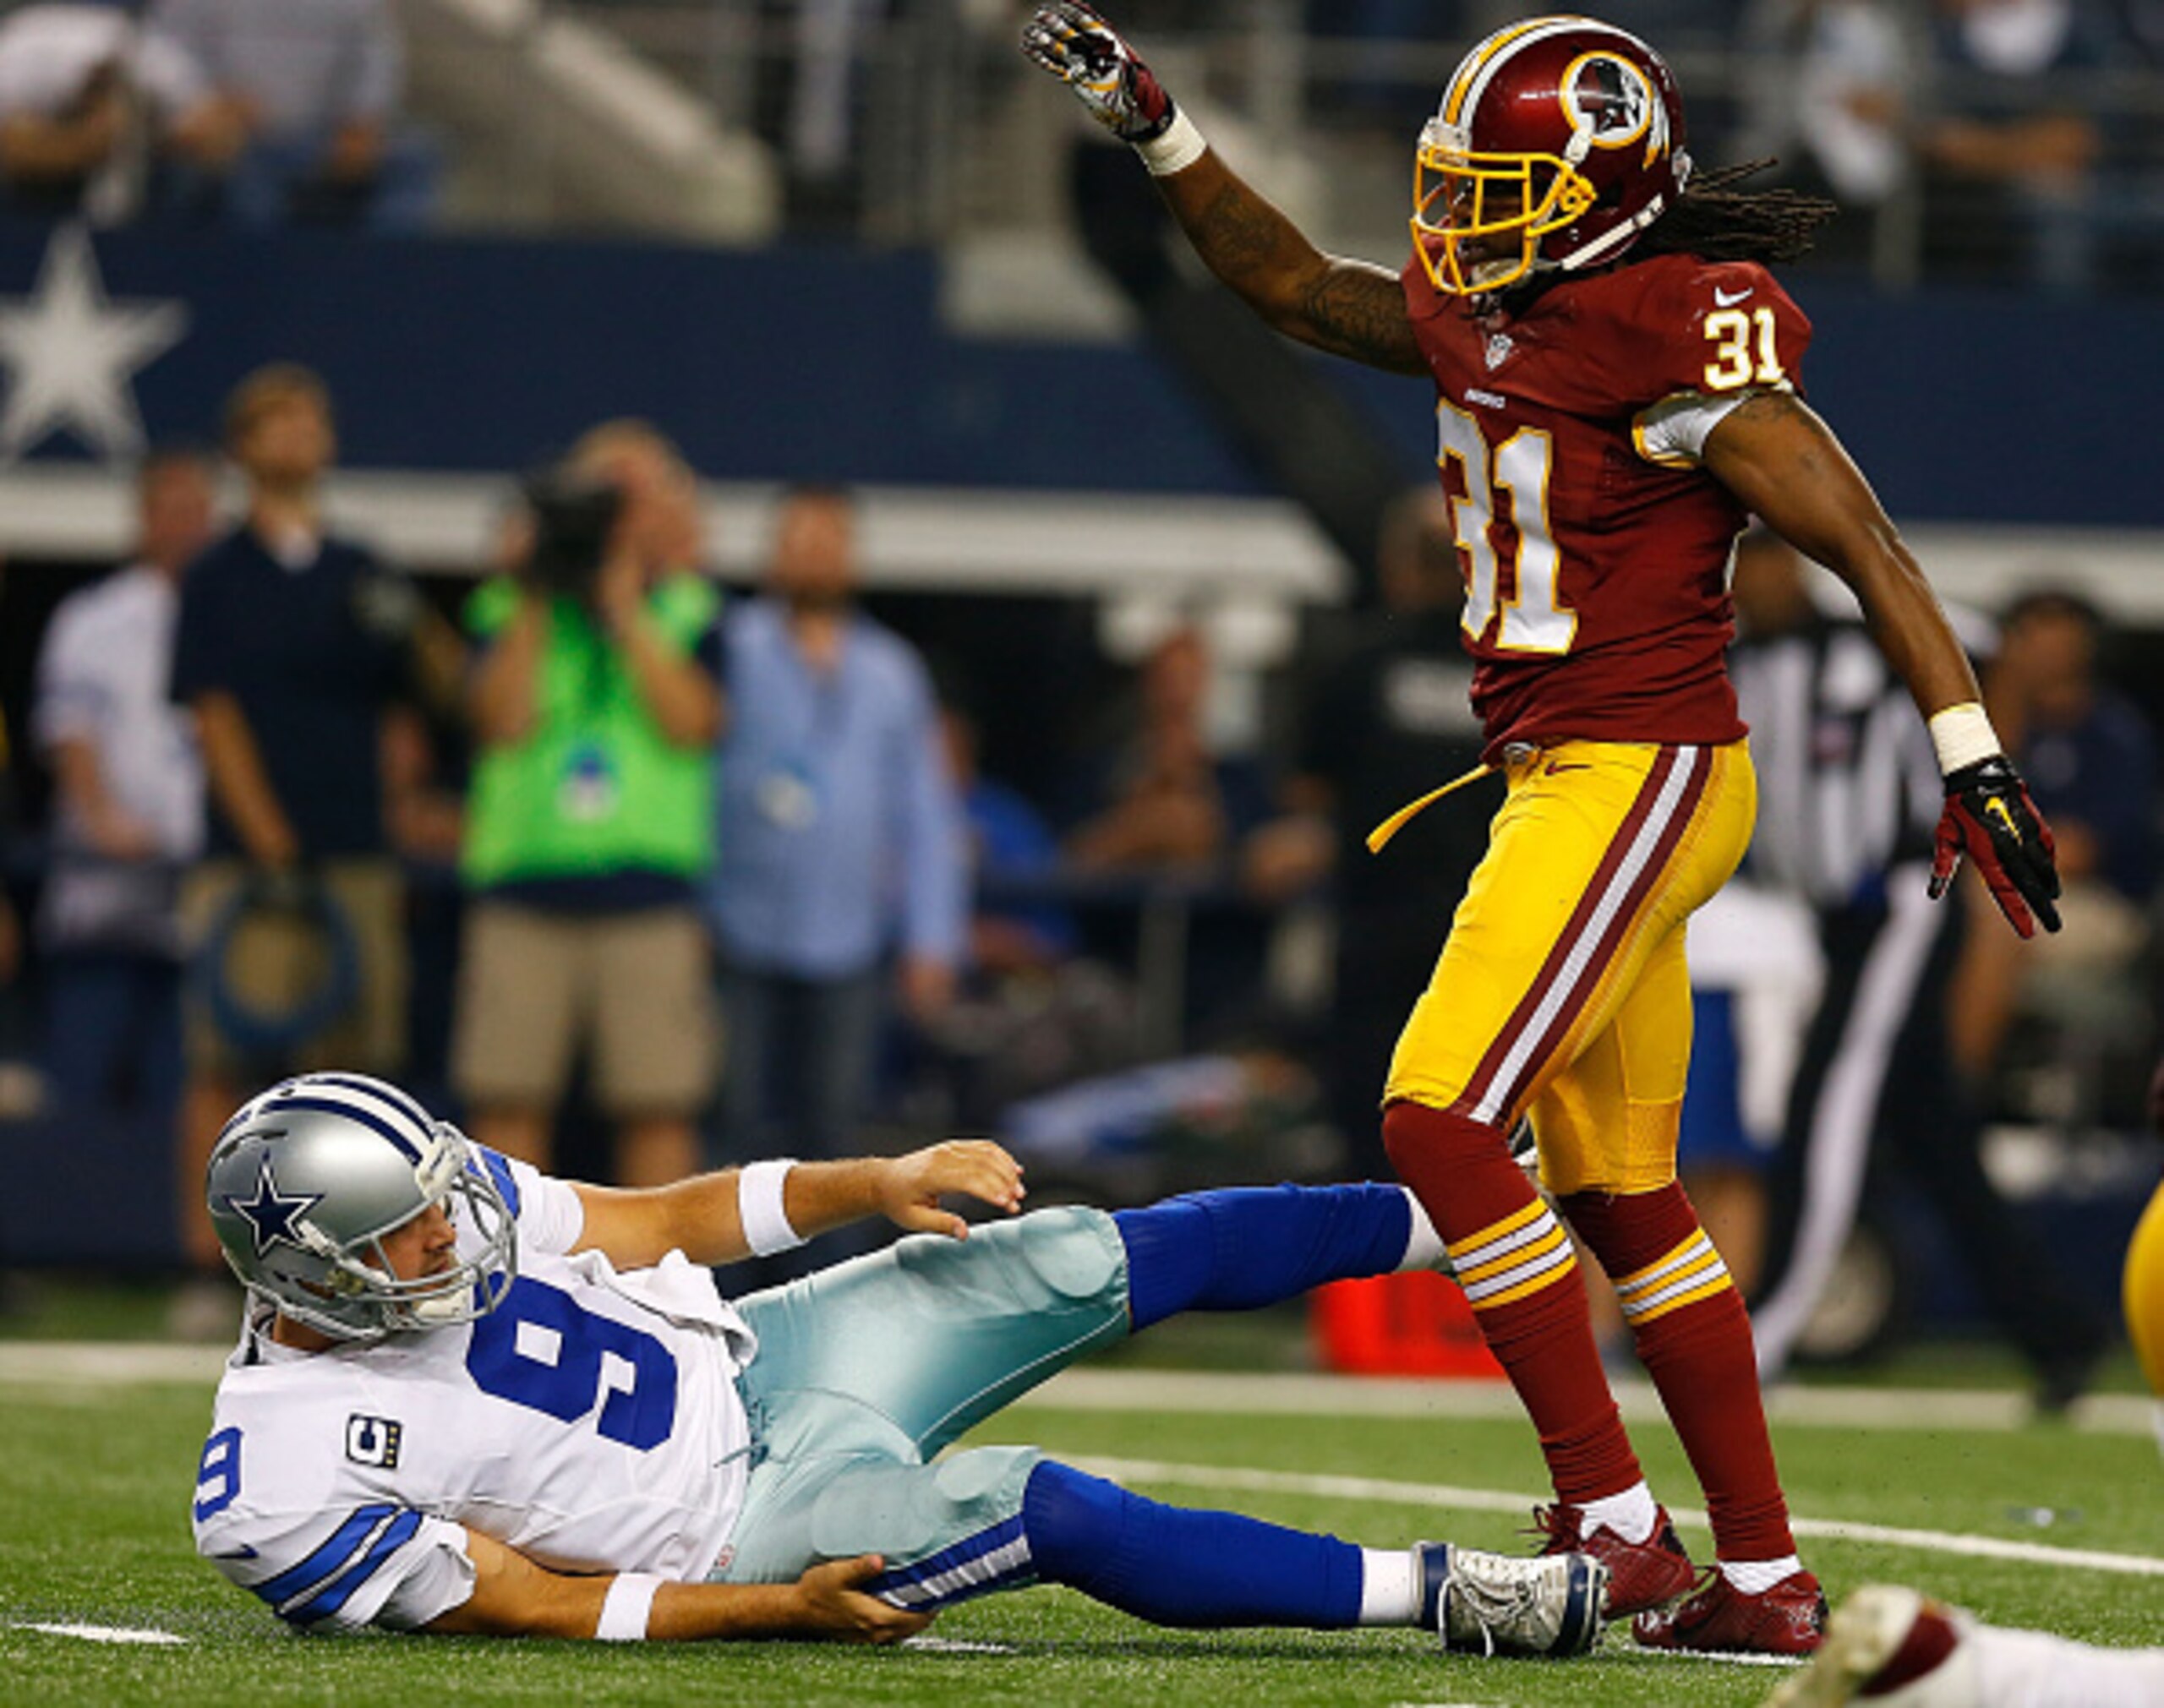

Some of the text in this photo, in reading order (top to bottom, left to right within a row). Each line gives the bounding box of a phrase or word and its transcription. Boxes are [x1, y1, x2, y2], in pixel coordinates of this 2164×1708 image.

[1703, 307, 1785, 390] 31
[1436, 400, 1577, 655] 31
[465, 1270, 678, 1453] 9
[195, 1427, 242, 1523] 9
[348, 1418, 386, 1464] C
